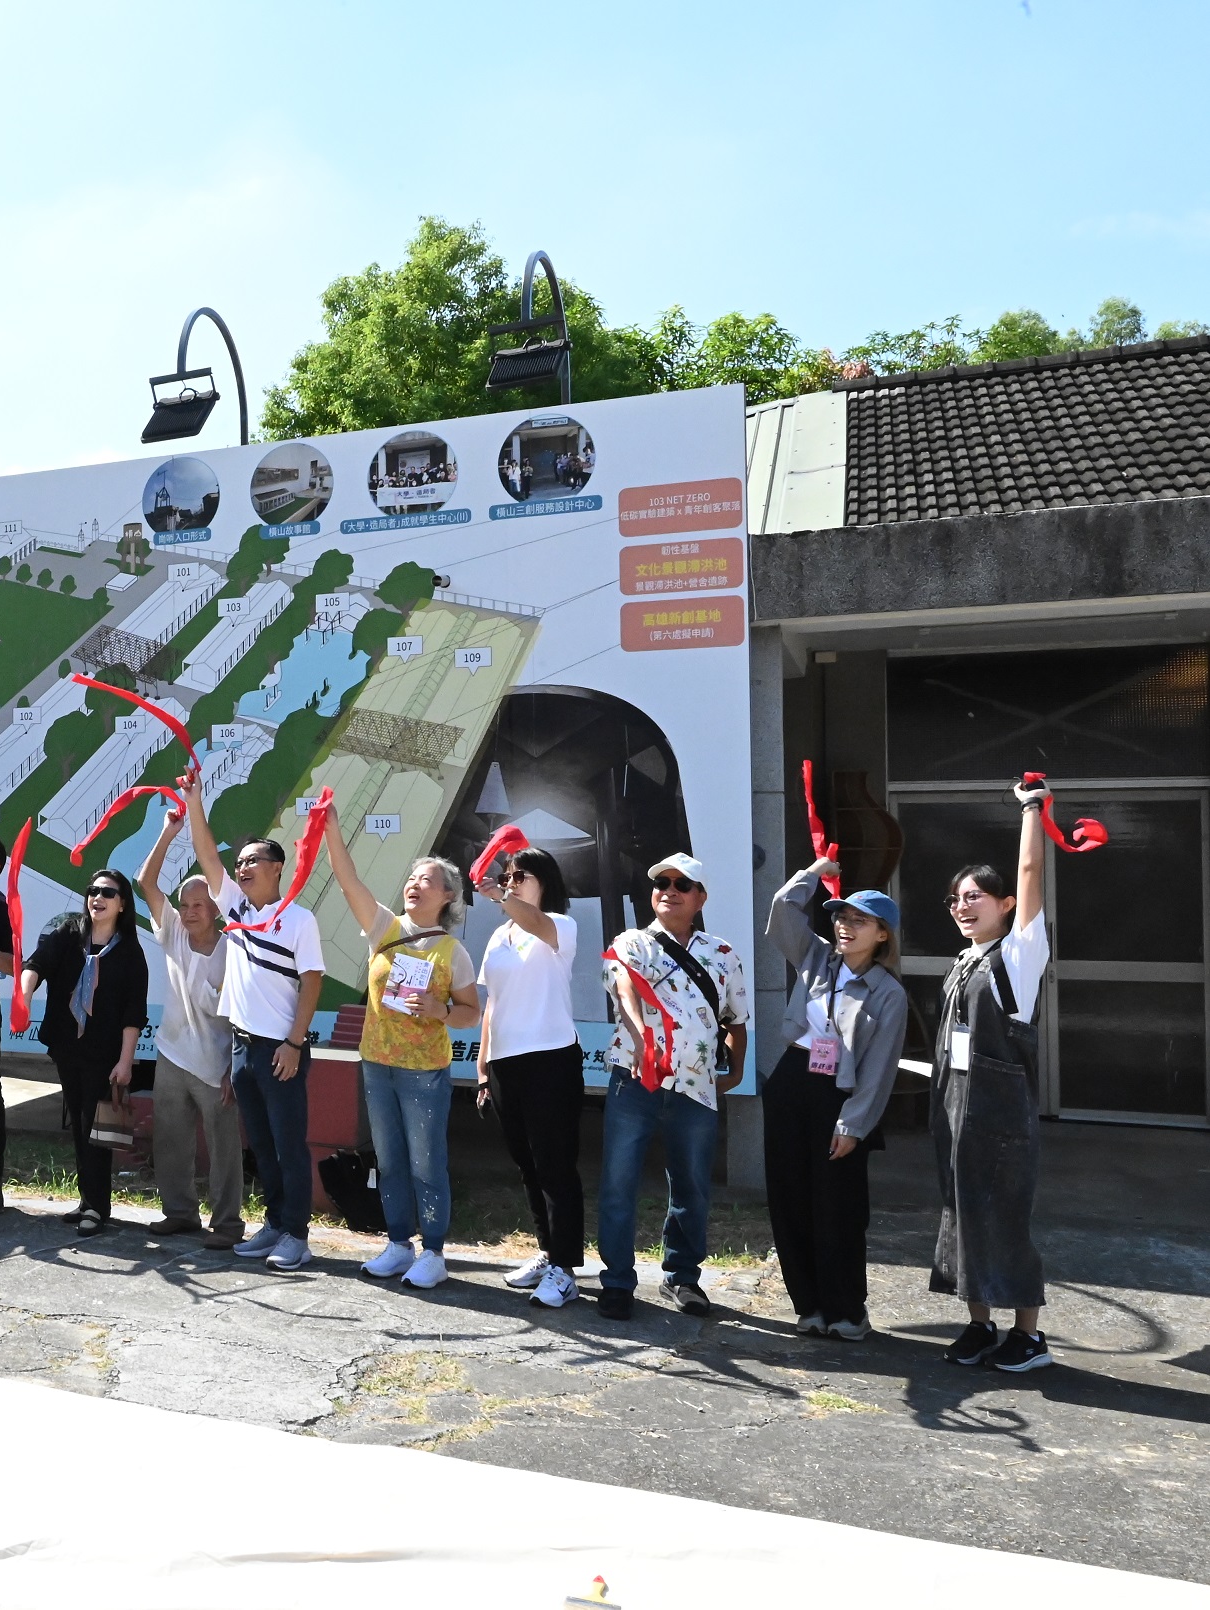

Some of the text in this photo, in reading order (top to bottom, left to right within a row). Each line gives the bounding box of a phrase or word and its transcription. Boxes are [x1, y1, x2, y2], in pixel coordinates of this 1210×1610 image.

[649, 492, 711, 507] 103 NET ZERO
[496, 499, 595, 518] 橫山三創服務設計中心
[4, 523, 17, 533] 111
[268, 523, 311, 537] 橫山故事館
[176, 567, 191, 577] 101
[226, 602, 241, 612] 103
[324, 597, 340, 607] 105
[396, 641, 412, 652] 107
[463, 652, 481, 664] 109
[20, 712, 34, 721] 102
[123, 720, 138, 730] 104
[220, 729, 236, 738] 106
[374, 818, 392, 829] 110
